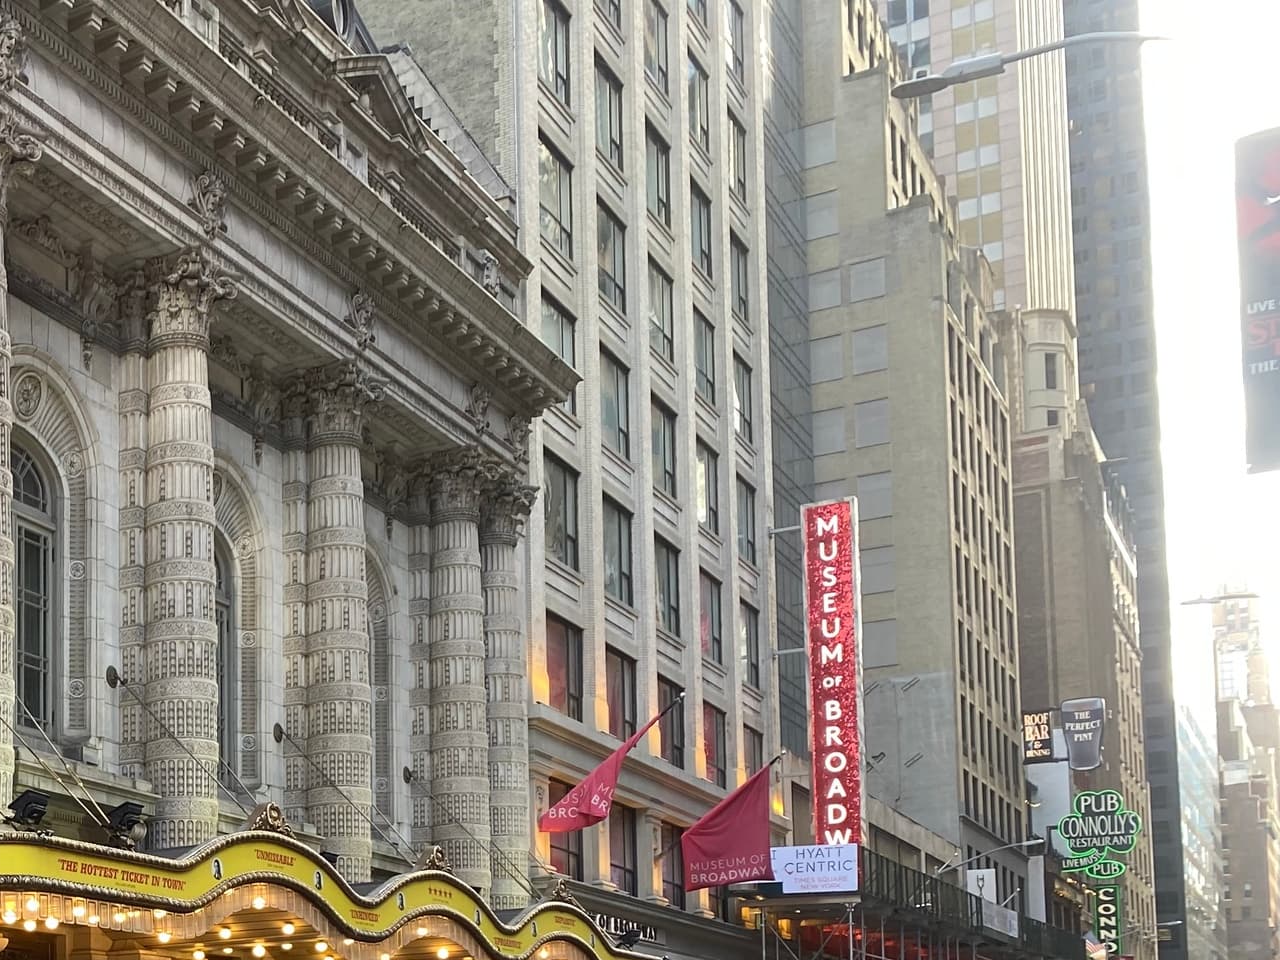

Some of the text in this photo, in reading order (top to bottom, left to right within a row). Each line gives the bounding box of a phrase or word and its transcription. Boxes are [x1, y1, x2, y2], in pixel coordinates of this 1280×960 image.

[1248, 299, 1275, 314] LIVE
[1248, 360, 1279, 375] THE
[817, 516, 844, 665] MUSEUM
[822, 675, 843, 689] OF
[1024, 713, 1049, 726] ROOF
[1074, 711, 1091, 720] THE
[1065, 720, 1100, 731] PERFECT
[1024, 725, 1049, 741] BAR
[1074, 732, 1093, 742] PINT
[1026, 749, 1051, 758] DINING
[1080, 794, 1119, 813] PUB
[1061, 814, 1137, 837] CONNOLLY'S
[1070, 835, 1132, 848] RESTAURANT
[796, 847, 844, 860] HYATT
[690, 857, 746, 872] MUSEUM
[750, 854, 767, 864] OF
[784, 860, 852, 875] CENTRIC
[1062, 858, 1080, 868] LIVE
[1093, 863, 1119, 875] PUB
[80, 863, 119, 880] HOTTEST
[120, 870, 150, 885] TICKET
[151, 876, 161, 887] IN
[691, 865, 767, 884] BROADWAY
